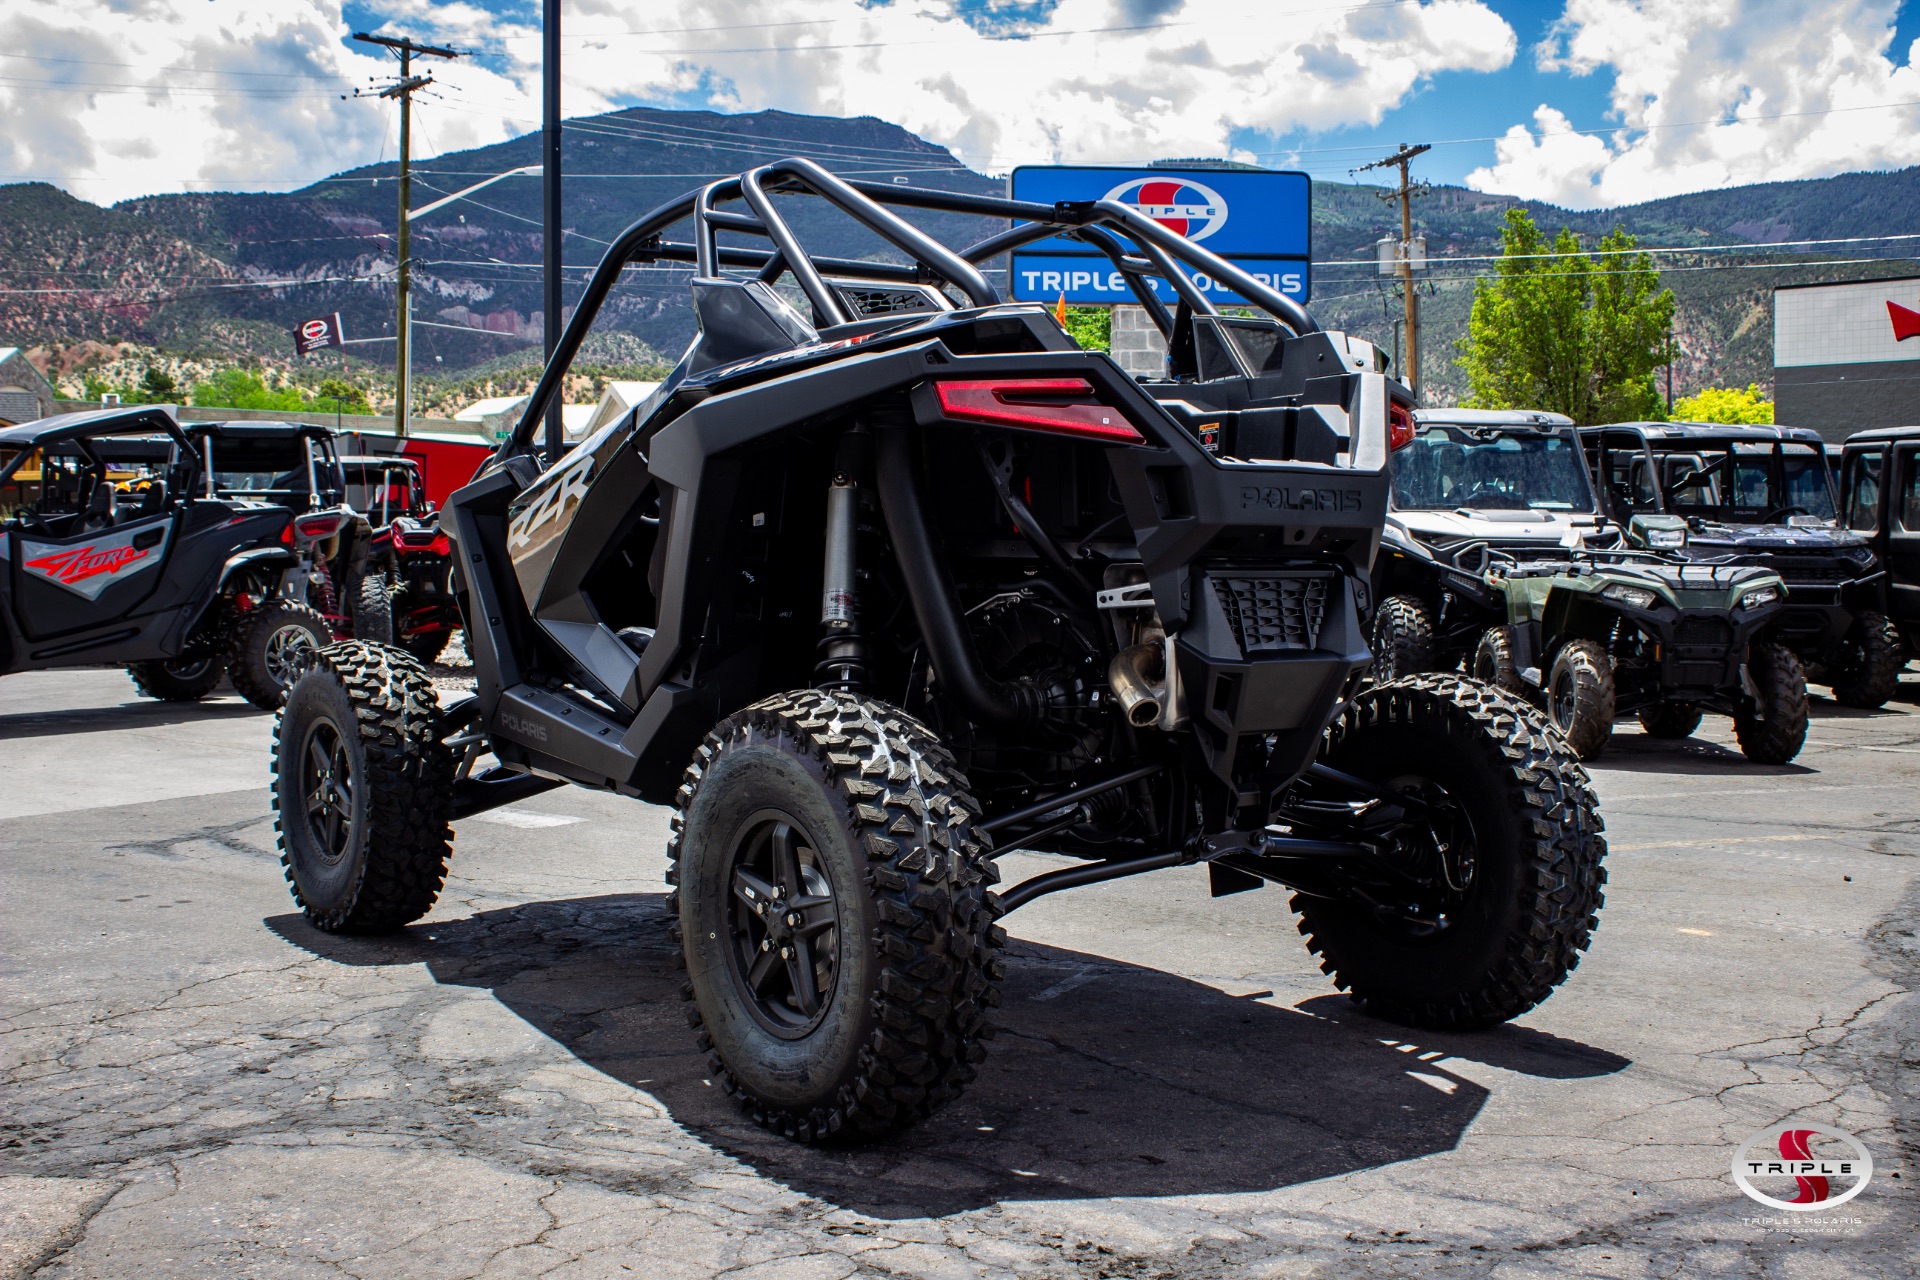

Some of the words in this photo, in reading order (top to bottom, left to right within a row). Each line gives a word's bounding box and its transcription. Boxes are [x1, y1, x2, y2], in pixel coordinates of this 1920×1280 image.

[1132, 207, 1216, 216] IPLE
[1021, 271, 1126, 292] TRIPLE
[1170, 272, 1302, 293] OLRIS
[506, 454, 595, 556] RZR
[1239, 486, 1362, 512] POLARIS
[501, 711, 548, 742] POLARIS
